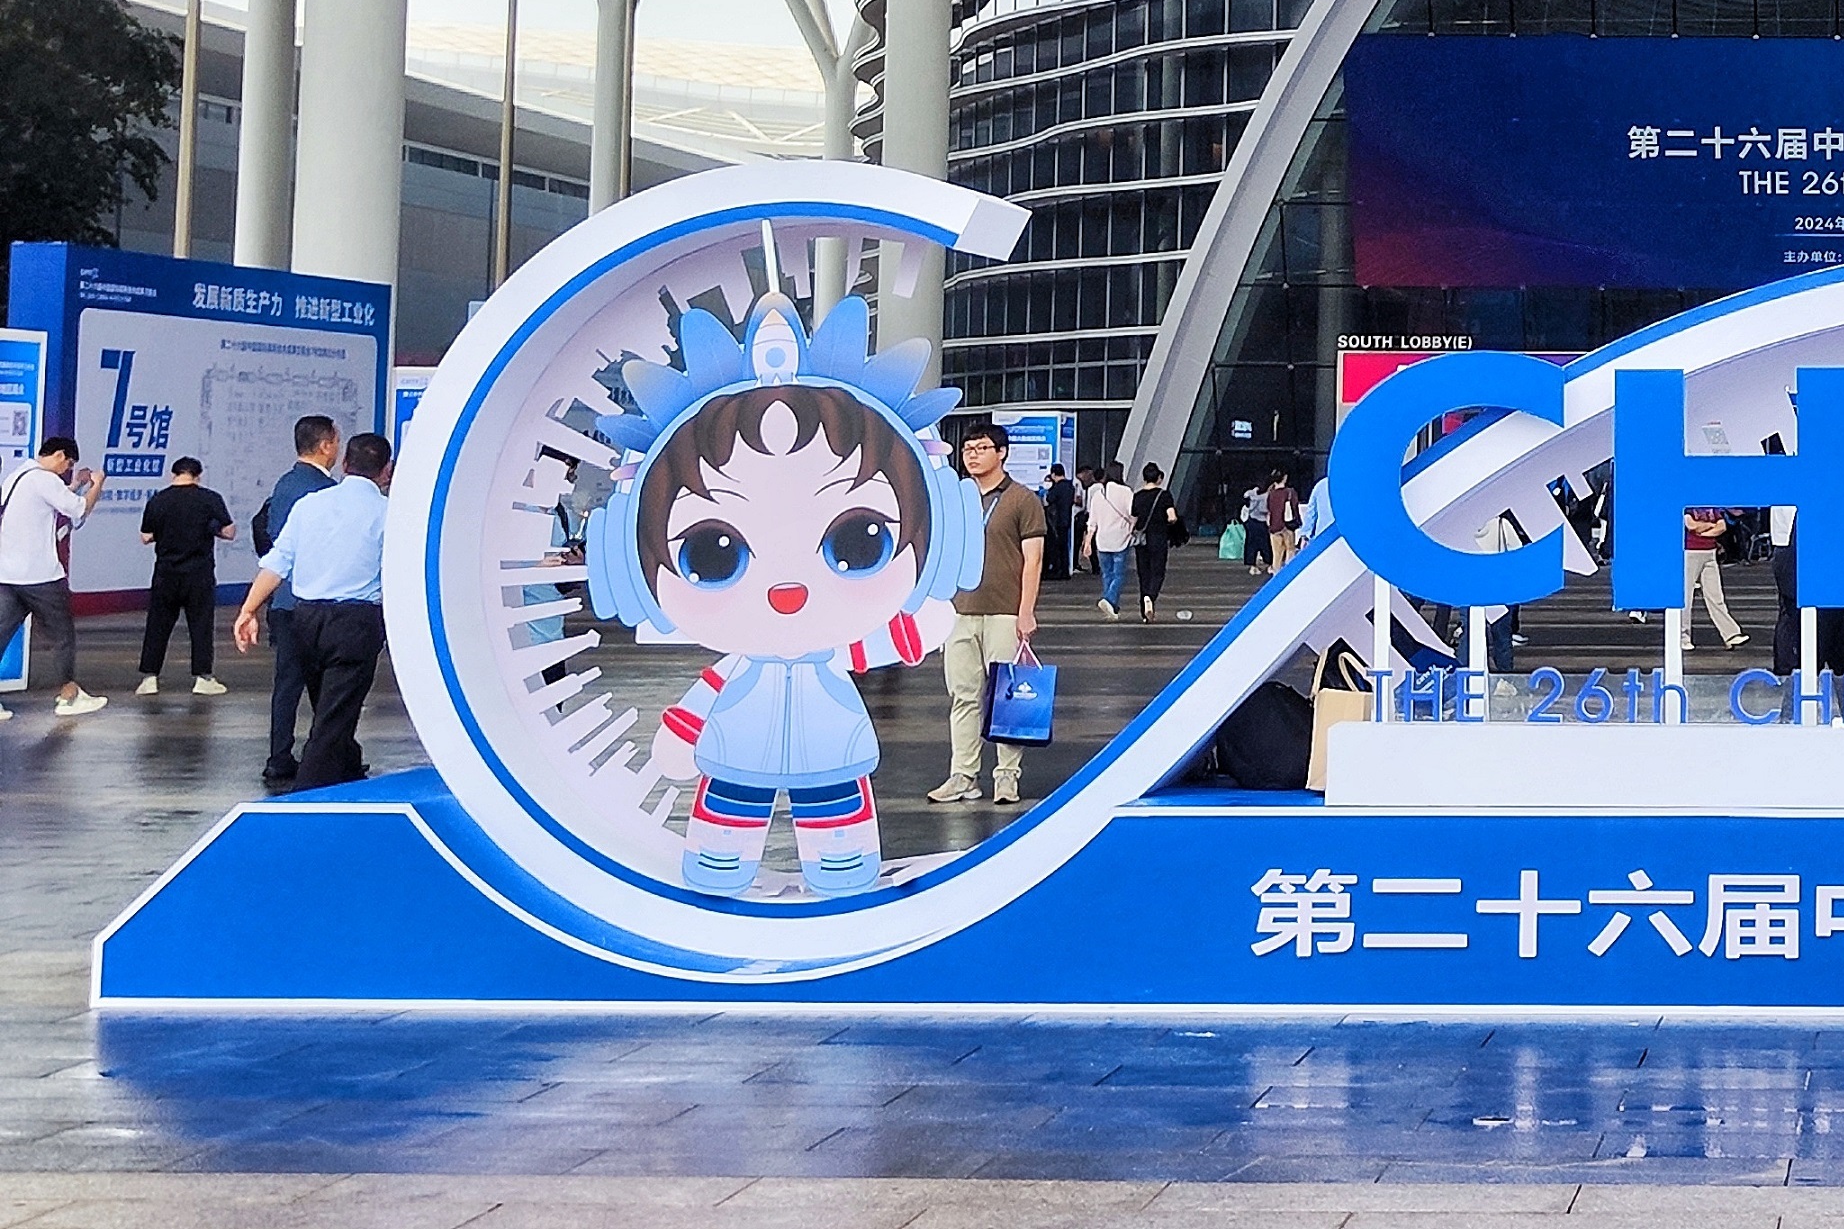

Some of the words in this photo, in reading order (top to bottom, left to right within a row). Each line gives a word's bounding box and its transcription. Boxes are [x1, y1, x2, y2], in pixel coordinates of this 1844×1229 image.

[1738, 170, 1789, 196] THE
[192, 282, 284, 317] 发展新质生产力
[295, 294, 376, 327] 推进新型工业化
[1337, 334, 1393, 349] SOUTH
[1400, 334, 1473, 350] LOBBY(E)
[1366, 668, 1486, 723] THE
[1527, 666, 1688, 724] 26th
